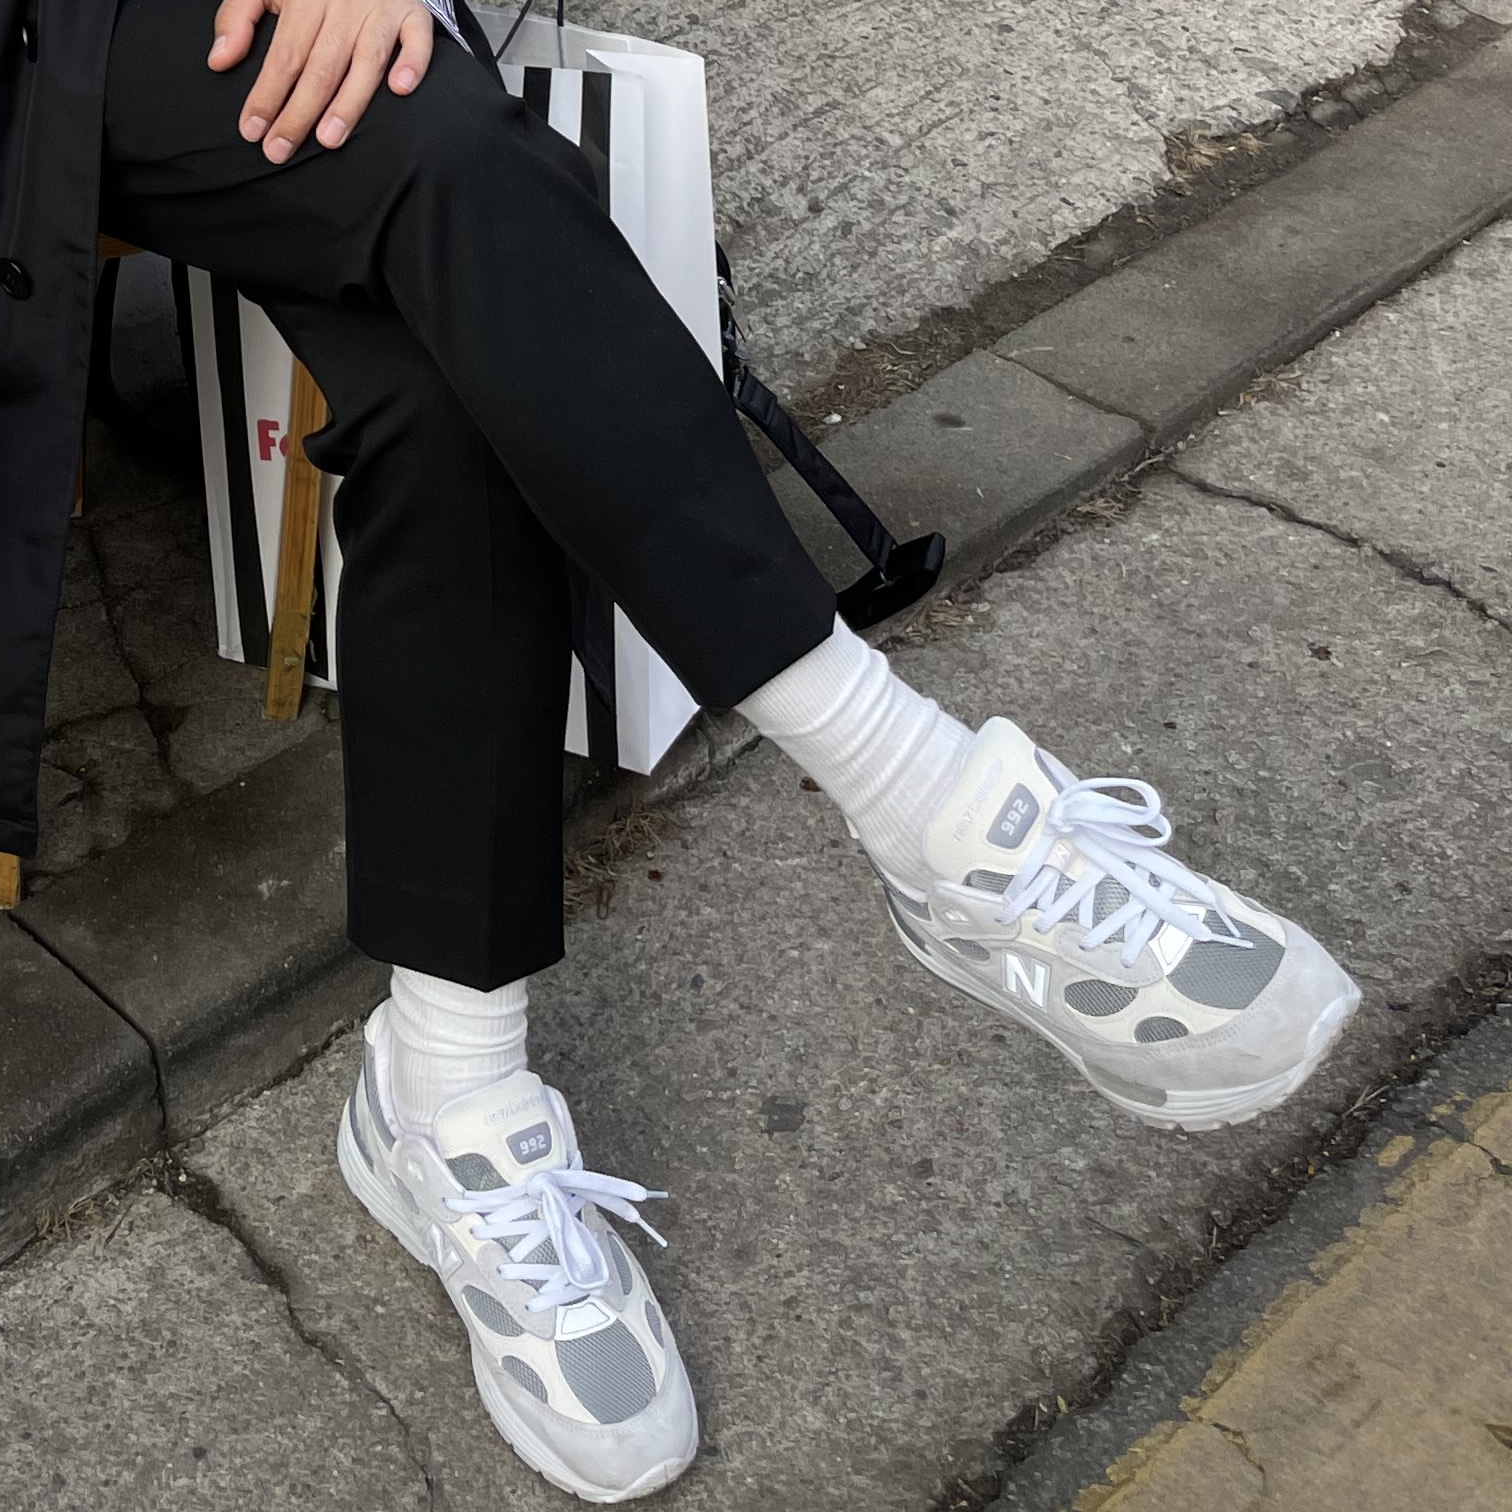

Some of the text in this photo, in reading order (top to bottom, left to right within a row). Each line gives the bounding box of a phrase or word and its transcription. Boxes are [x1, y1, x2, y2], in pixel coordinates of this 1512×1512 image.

[1000, 798, 1029, 837] 992
[1002, 950, 1052, 1011] N
[519, 1133, 547, 1156] 992
